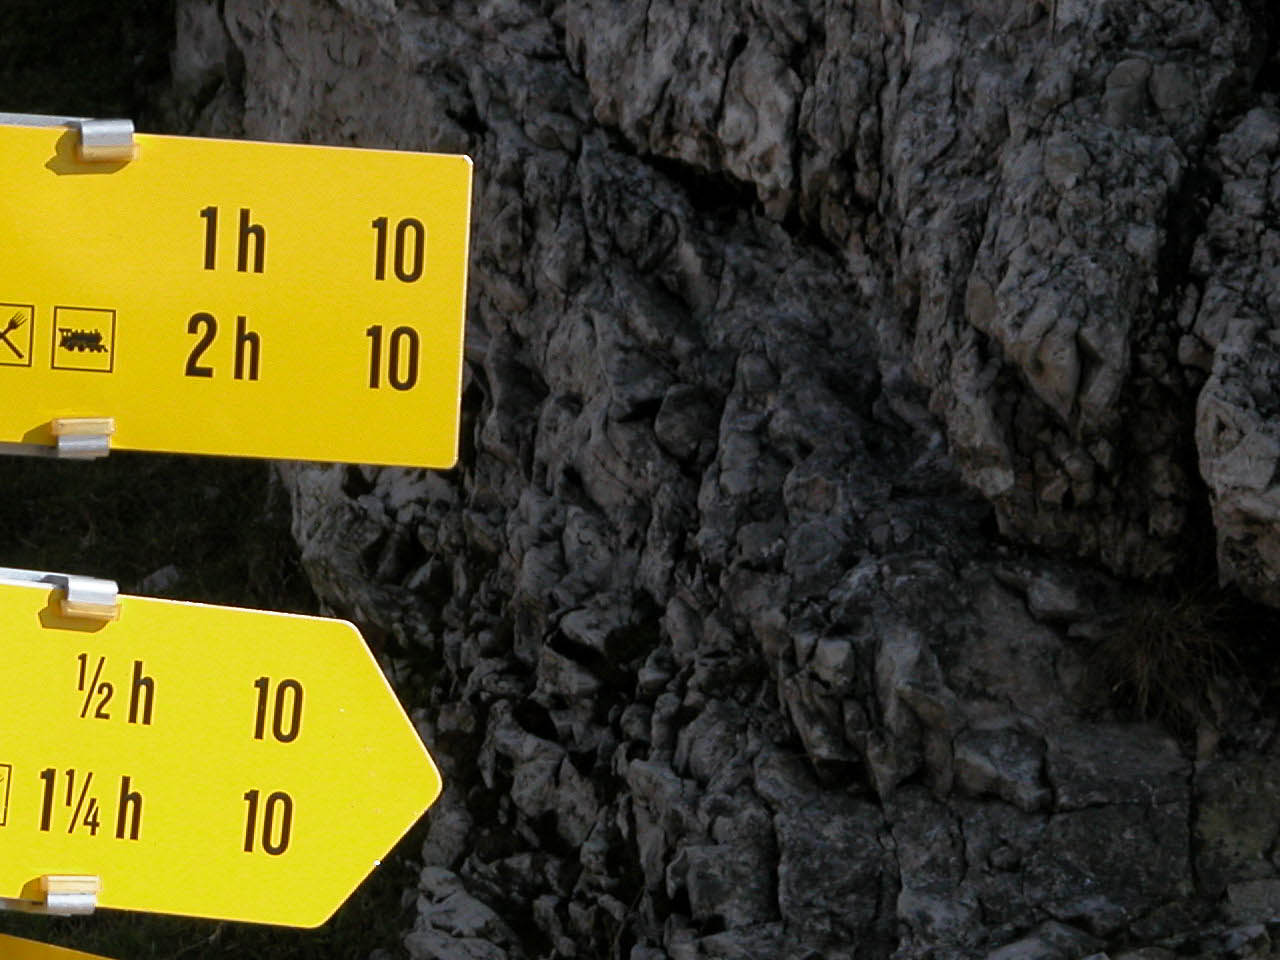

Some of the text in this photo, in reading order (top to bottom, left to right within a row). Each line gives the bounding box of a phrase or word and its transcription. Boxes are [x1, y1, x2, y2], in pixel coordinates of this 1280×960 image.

[199, 205, 219, 271] 1
[236, 207, 266, 275] h
[371, 215, 426, 284] 10
[184, 311, 218, 379] 2
[232, 315, 261, 382] h
[365, 324, 420, 392] 10
[128, 659, 155, 726] h
[253, 675, 304, 744] 10
[114, 775, 143, 841] h
[242, 789, 294, 857] 10
